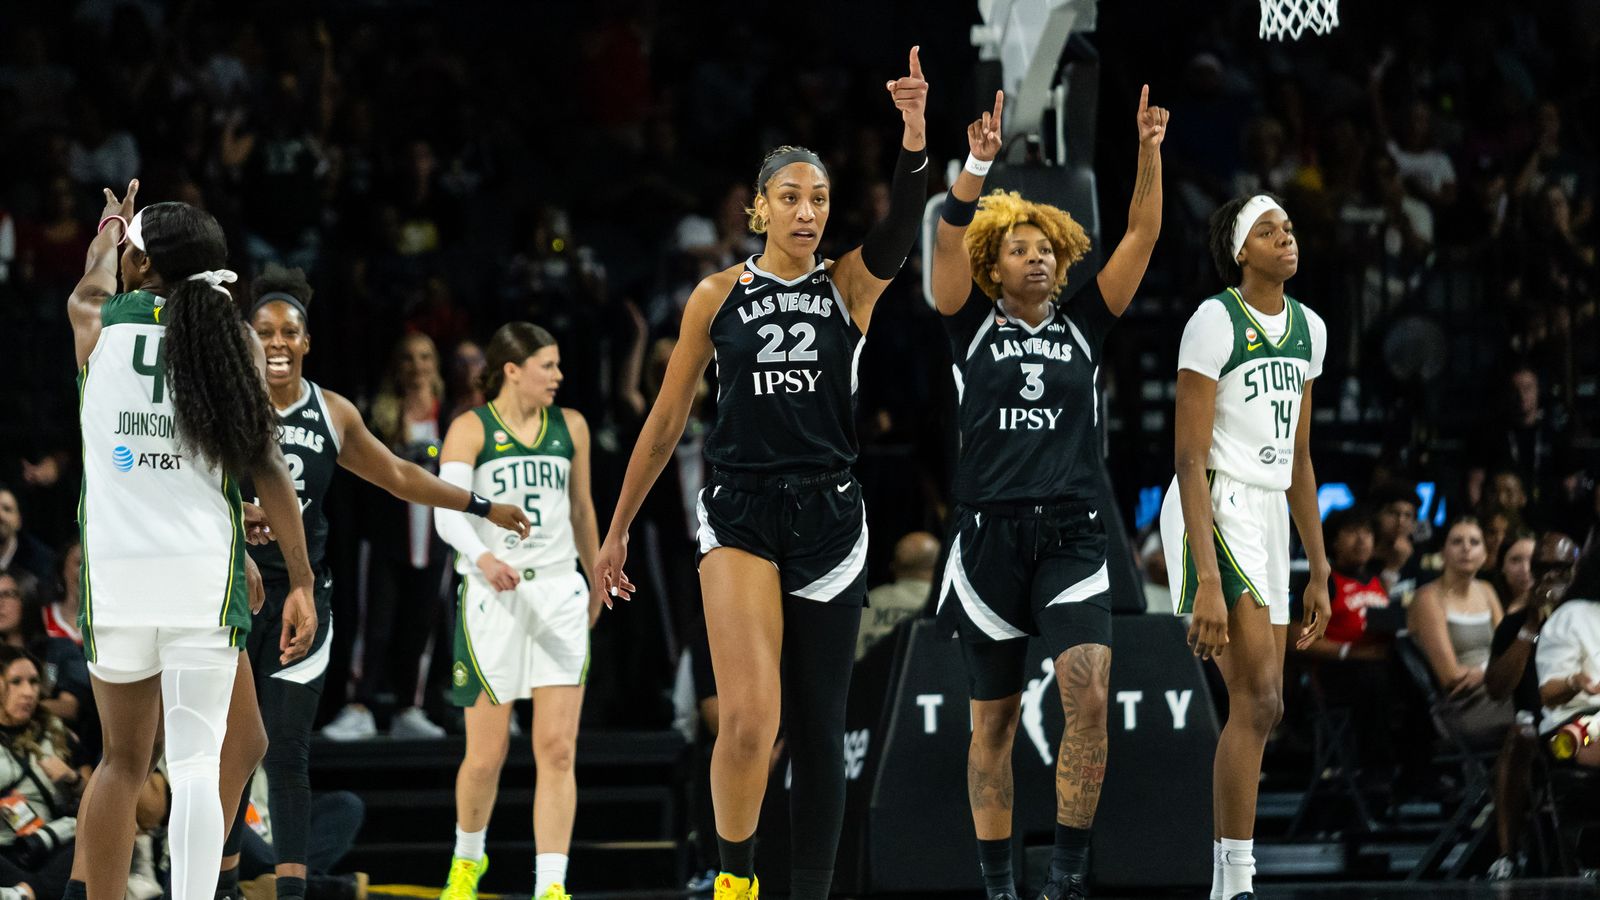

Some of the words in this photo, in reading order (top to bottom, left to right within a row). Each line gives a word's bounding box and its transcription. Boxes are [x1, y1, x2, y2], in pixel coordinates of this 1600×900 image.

[811, 273, 831, 285] ally
[737, 295, 776, 325] LAS
[776, 292, 833, 318] VEGAS
[757, 322, 818, 363] 22
[1047, 323, 1066, 334] ally
[990, 339, 1024, 362] LAS
[1022, 337, 1073, 362] VEGAS
[132, 334, 165, 404] 4
[752, 369, 822, 396] IPSY
[1019, 363, 1045, 400] 3
[1244, 361, 1306, 403] STORM
[114, 411, 175, 439] JOHNSON
[302, 409, 320, 421] ally
[999, 408, 1063, 430] IPSY
[1271, 400, 1292, 439] 14
[138, 453, 183, 470] AT&T
[493, 460, 566, 497] STORM
[523, 494, 541, 527] 5
